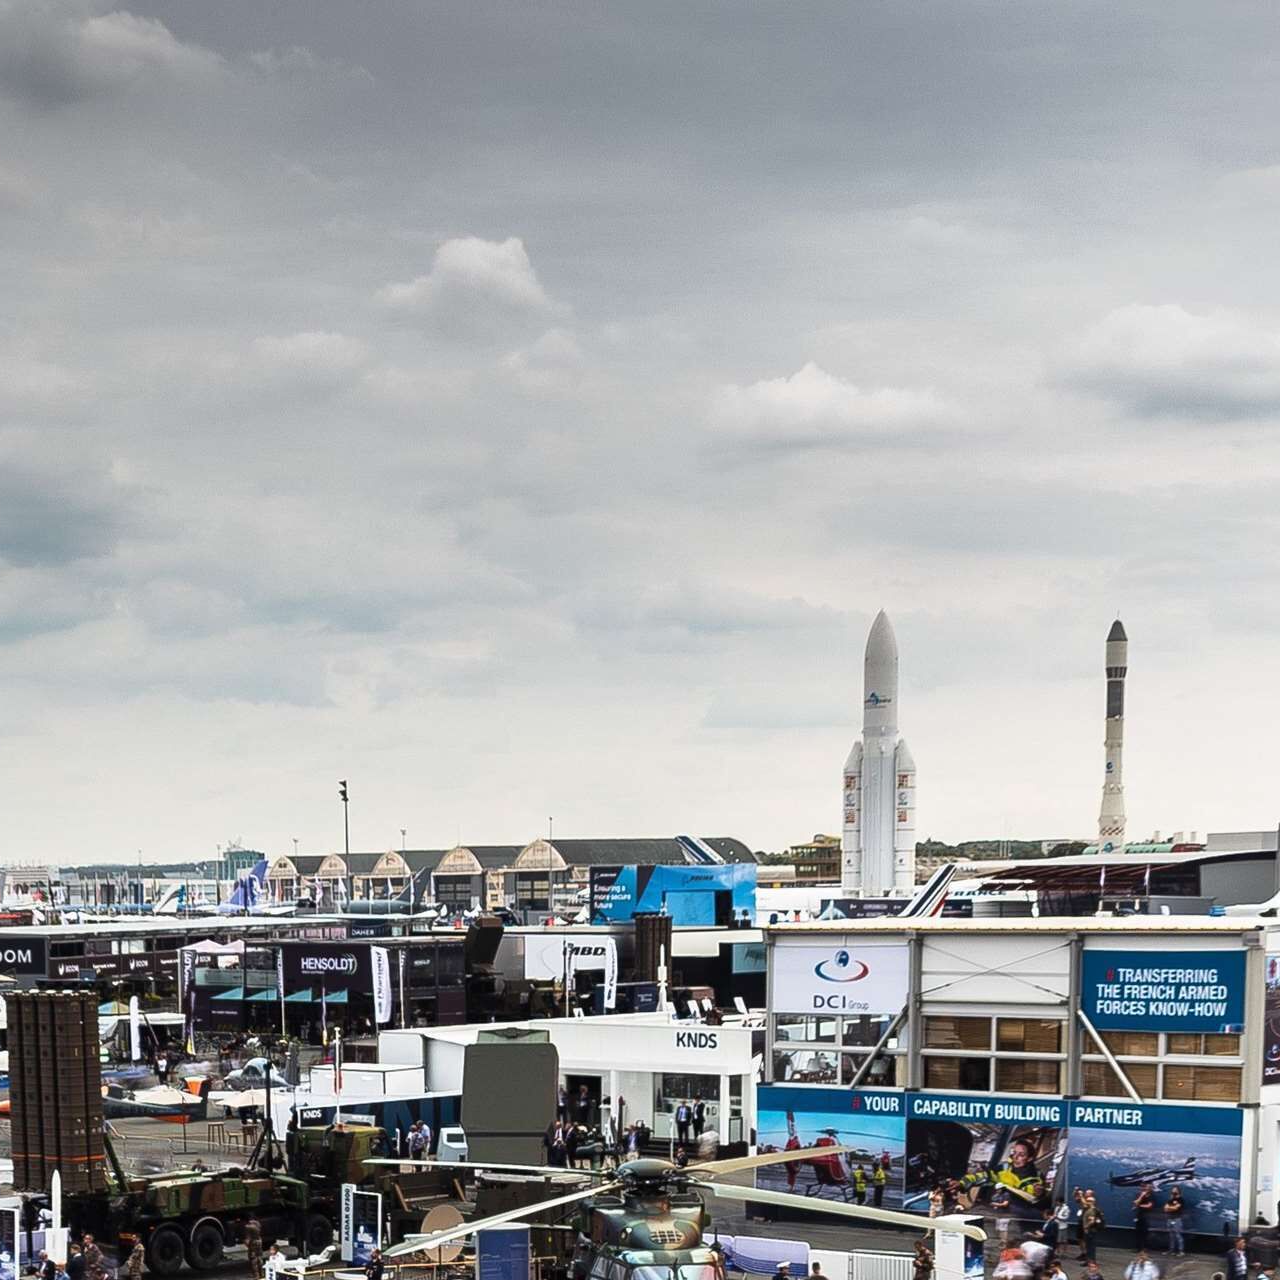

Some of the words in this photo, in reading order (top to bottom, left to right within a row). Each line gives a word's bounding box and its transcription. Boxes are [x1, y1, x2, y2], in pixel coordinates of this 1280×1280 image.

[563, 943, 607, 956] MBD
[300, 956, 353, 971] HENSOLDT
[1118, 968, 1218, 983] TRANSFERRING
[1096, 984, 1121, 998] THE
[1124, 984, 1174, 999] FRENCH
[1179, 985, 1227, 1000] ARMED
[814, 995, 847, 1009] DCI
[849, 1000, 870, 1011] Group
[1096, 1001, 1146, 1015] FORCES
[1149, 1001, 1227, 1017] KNOW-HOW
[676, 1032, 718, 1049] KNDS
[303, 1109, 321, 1119] KNDS
[864, 1097, 900, 1112] YOUR
[914, 1099, 991, 1119] CAPABILITY
[994, 1103, 1061, 1122] BUILDING
[1075, 1107, 1143, 1125] PARTNER
